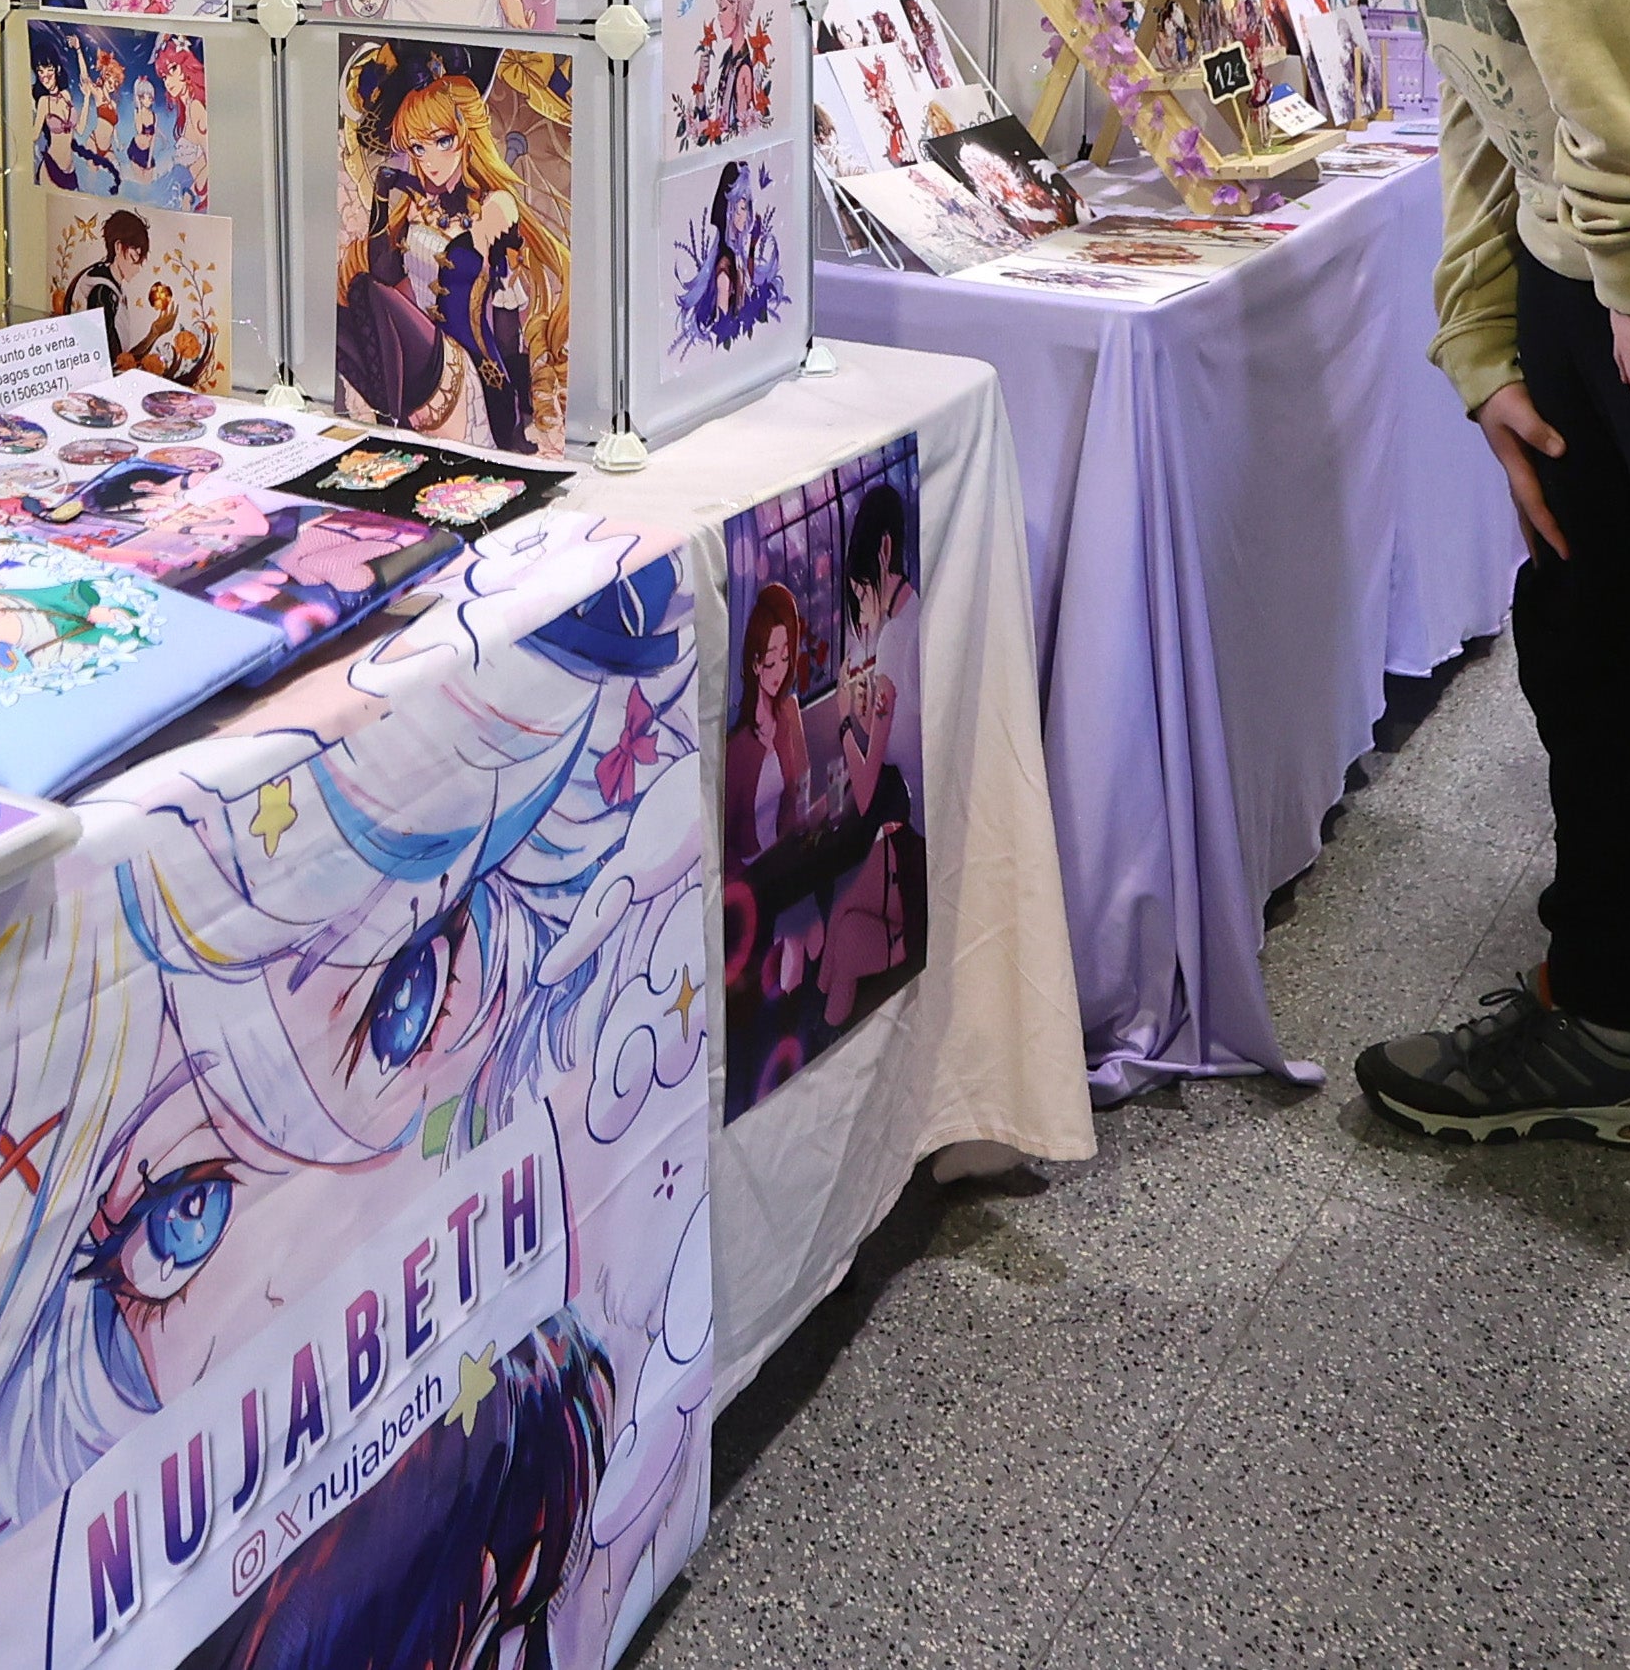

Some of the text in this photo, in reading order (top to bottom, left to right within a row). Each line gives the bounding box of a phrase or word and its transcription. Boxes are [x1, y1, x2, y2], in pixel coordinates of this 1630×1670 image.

[1214, 61, 1244, 89] 12€
[1, 335, 11, 345] 3€
[27, 343, 42, 358] de
[47, 336, 79, 353] venta.
[33, 362, 53, 377] con
[56, 350, 90, 370] tarjeta
[93, 352, 101, 361] o
[0, 377, 72, 408] (615063347).
[85, 1154, 545, 1646] NUJABETH
[307, 1369, 445, 1525] nujabeth
